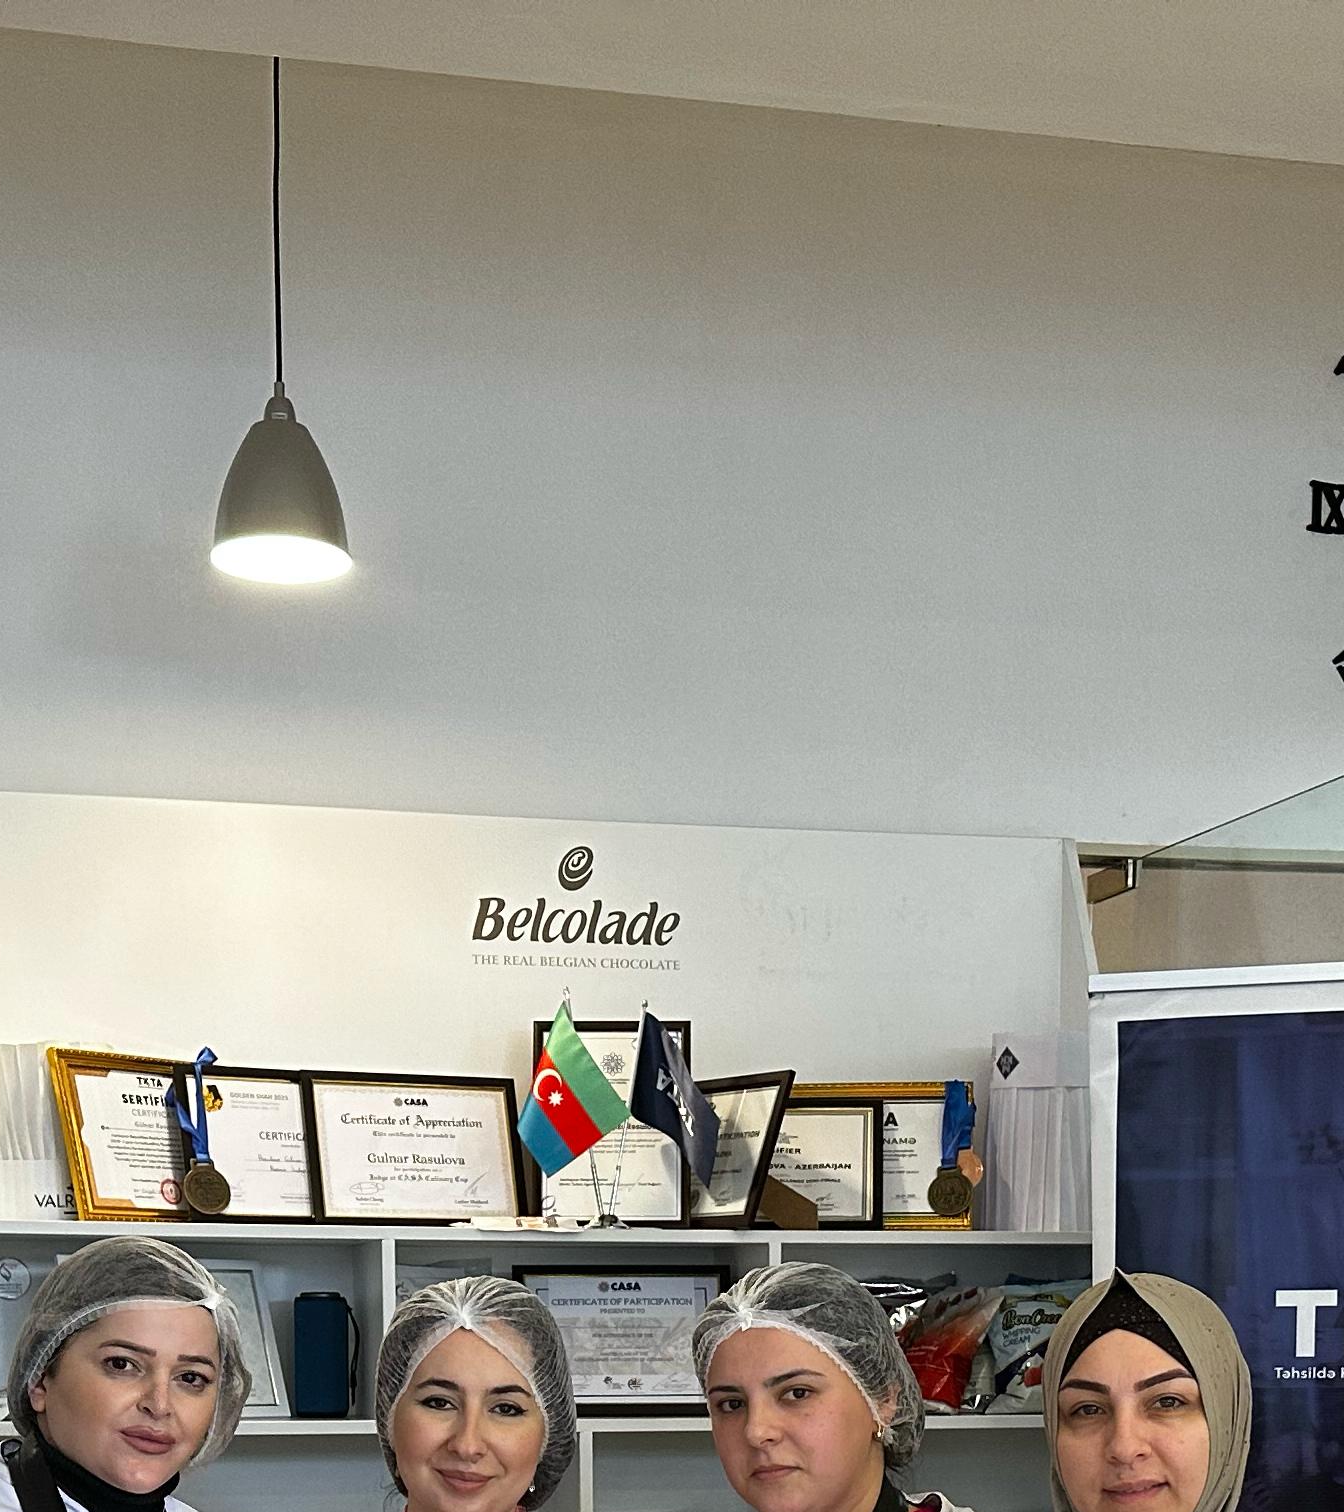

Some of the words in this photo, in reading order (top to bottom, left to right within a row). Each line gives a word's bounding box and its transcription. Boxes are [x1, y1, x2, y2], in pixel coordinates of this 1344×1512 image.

[472, 897, 681, 947] Belcolade
[472, 954, 499, 966] THE
[503, 956, 536, 968] REAL
[540, 956, 597, 969] BELGIAN
[601, 958, 681, 971] CHOCOLATE
[404, 1098, 429, 1107] CASA
[340, 1112, 396, 1126] Certificate
[399, 1115, 411, 1126] of
[413, 1114, 483, 1129] Appreciation
[367, 1153, 409, 1164] Gulnar
[412, 1154, 465, 1165] Rasulova
[611, 1282, 641, 1292] CASA
[551, 1298, 608, 1306] CERTIFICATE
[610, 1298, 622, 1306] OF
[623, 1298, 693, 1306] PARTICIPATION
[1274, 1367, 1336, 1379] Təhsildə
